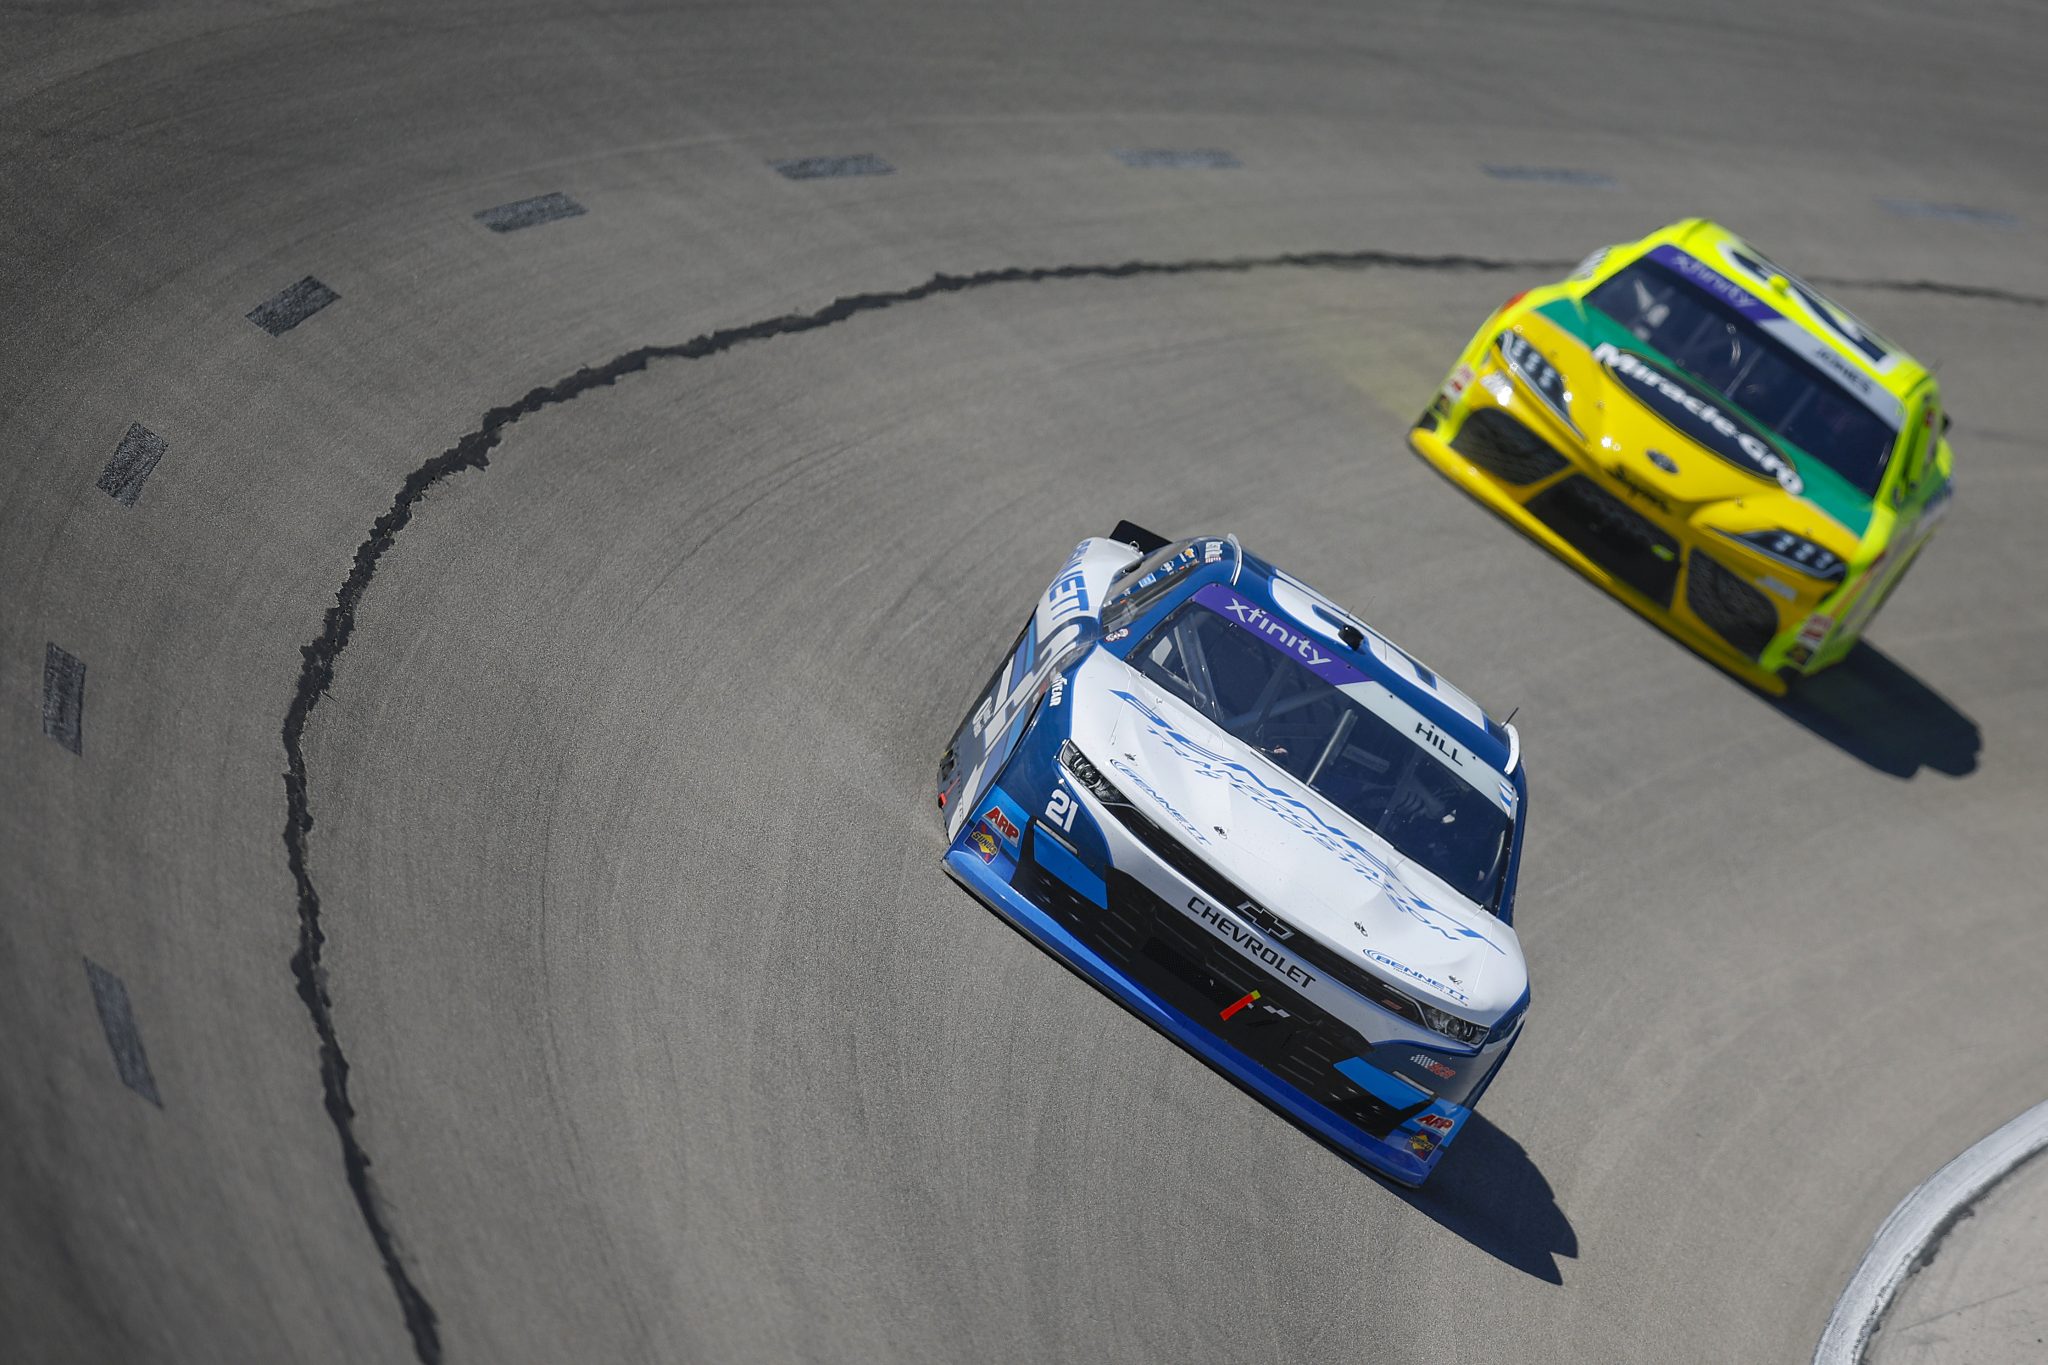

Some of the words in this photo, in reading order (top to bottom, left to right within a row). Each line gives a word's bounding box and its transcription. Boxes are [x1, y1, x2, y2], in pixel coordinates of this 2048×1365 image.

[1225, 598, 1333, 666] xfinity
[1415, 721, 1464, 767] HILL
[984, 807, 1019, 840] ARP
[1045, 789, 1078, 833] 21
[1187, 896, 1316, 988] CHEVROLET
[1376, 954, 1470, 1001] BENNETT
